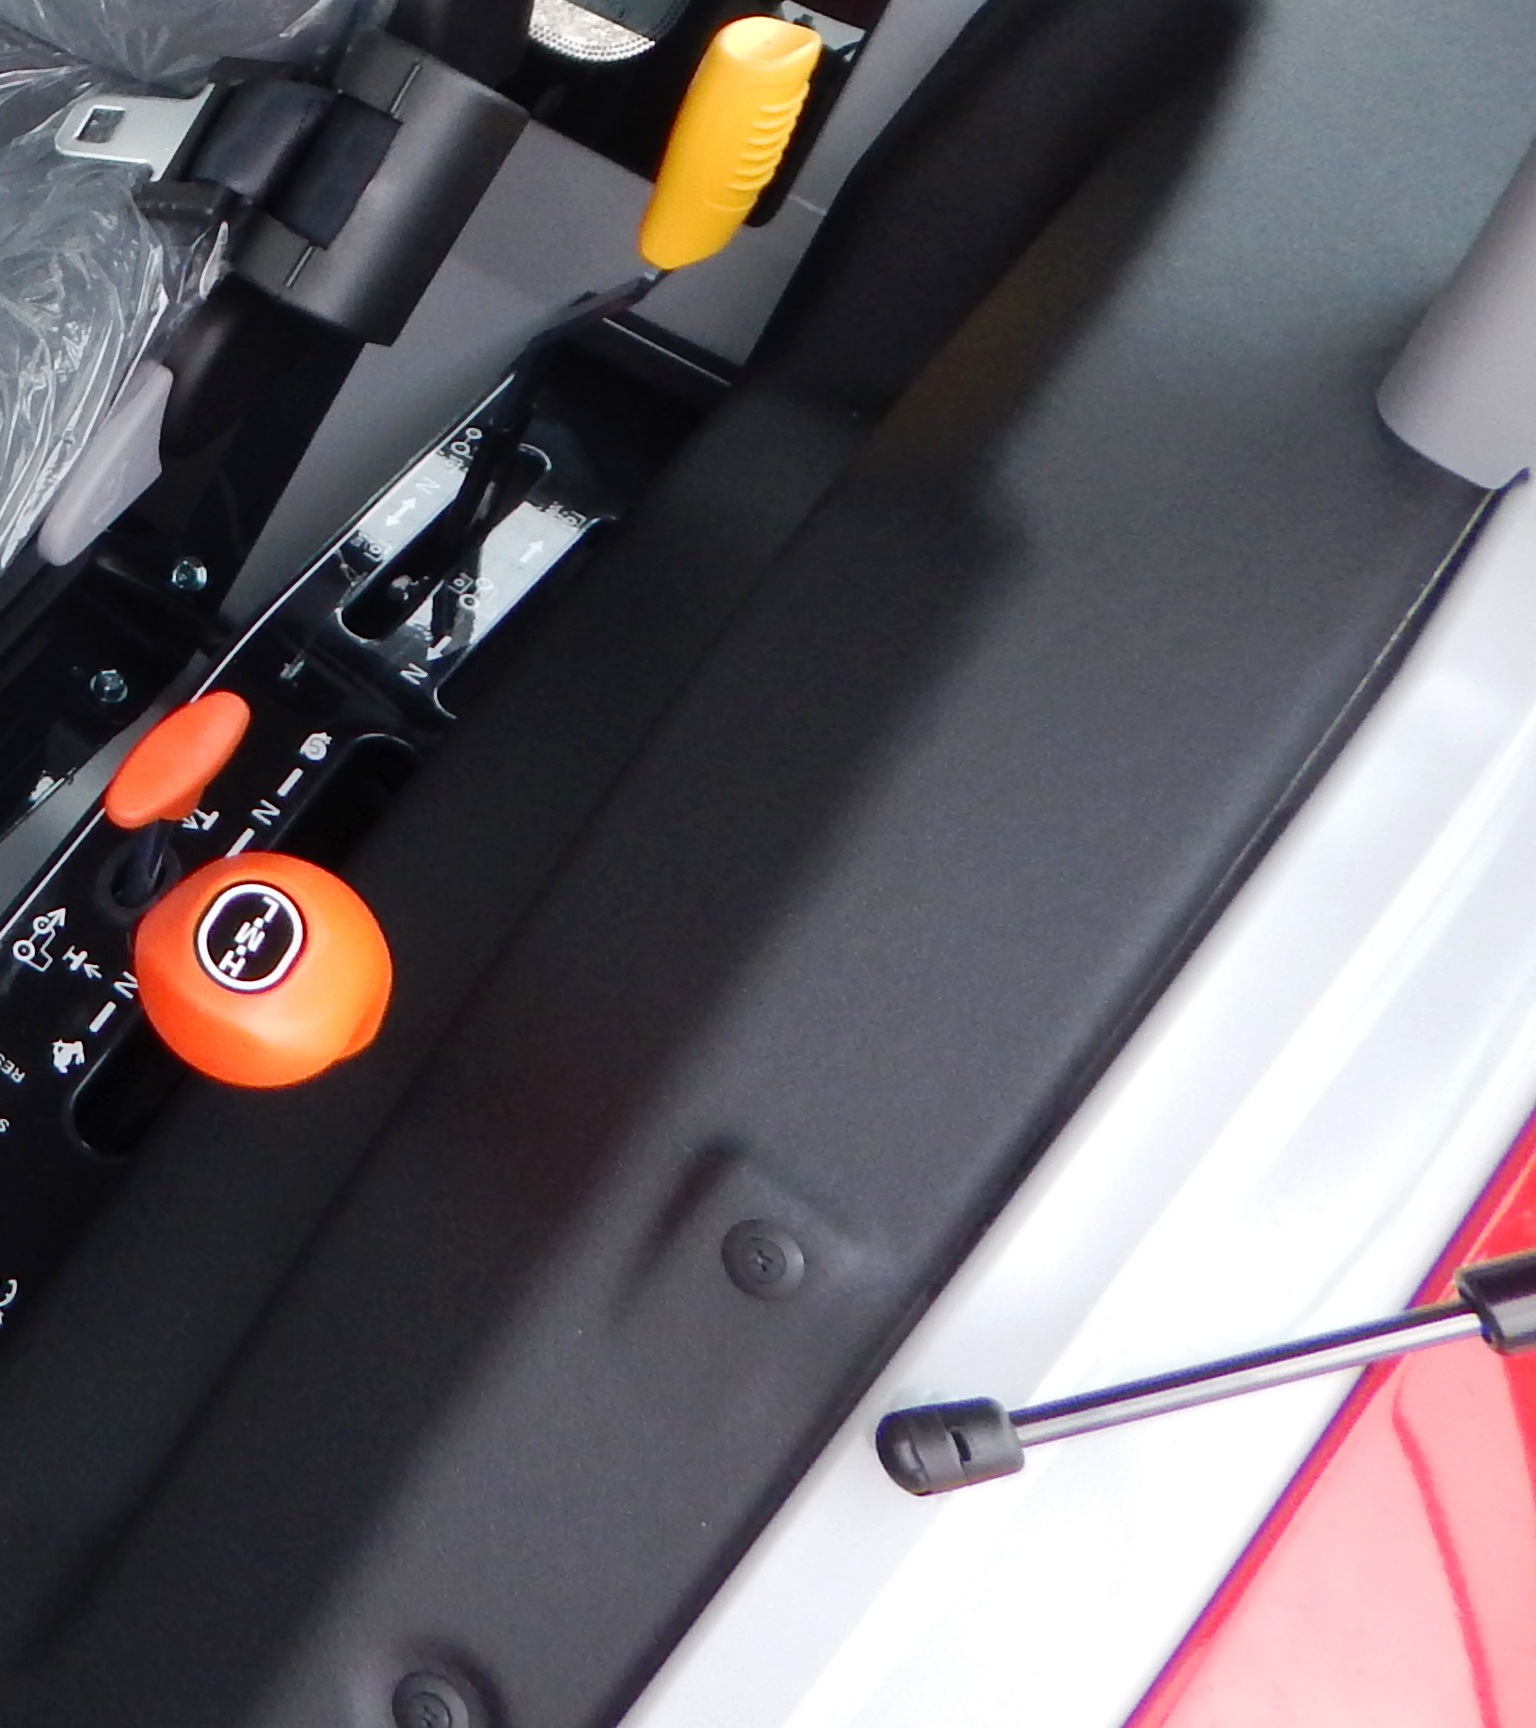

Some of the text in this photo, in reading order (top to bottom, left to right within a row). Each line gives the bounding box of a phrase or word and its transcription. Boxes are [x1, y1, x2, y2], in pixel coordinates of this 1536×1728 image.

[400, 663, 428, 685] N
[251, 799, 281, 826] N
[112, 971, 139, 999] N
